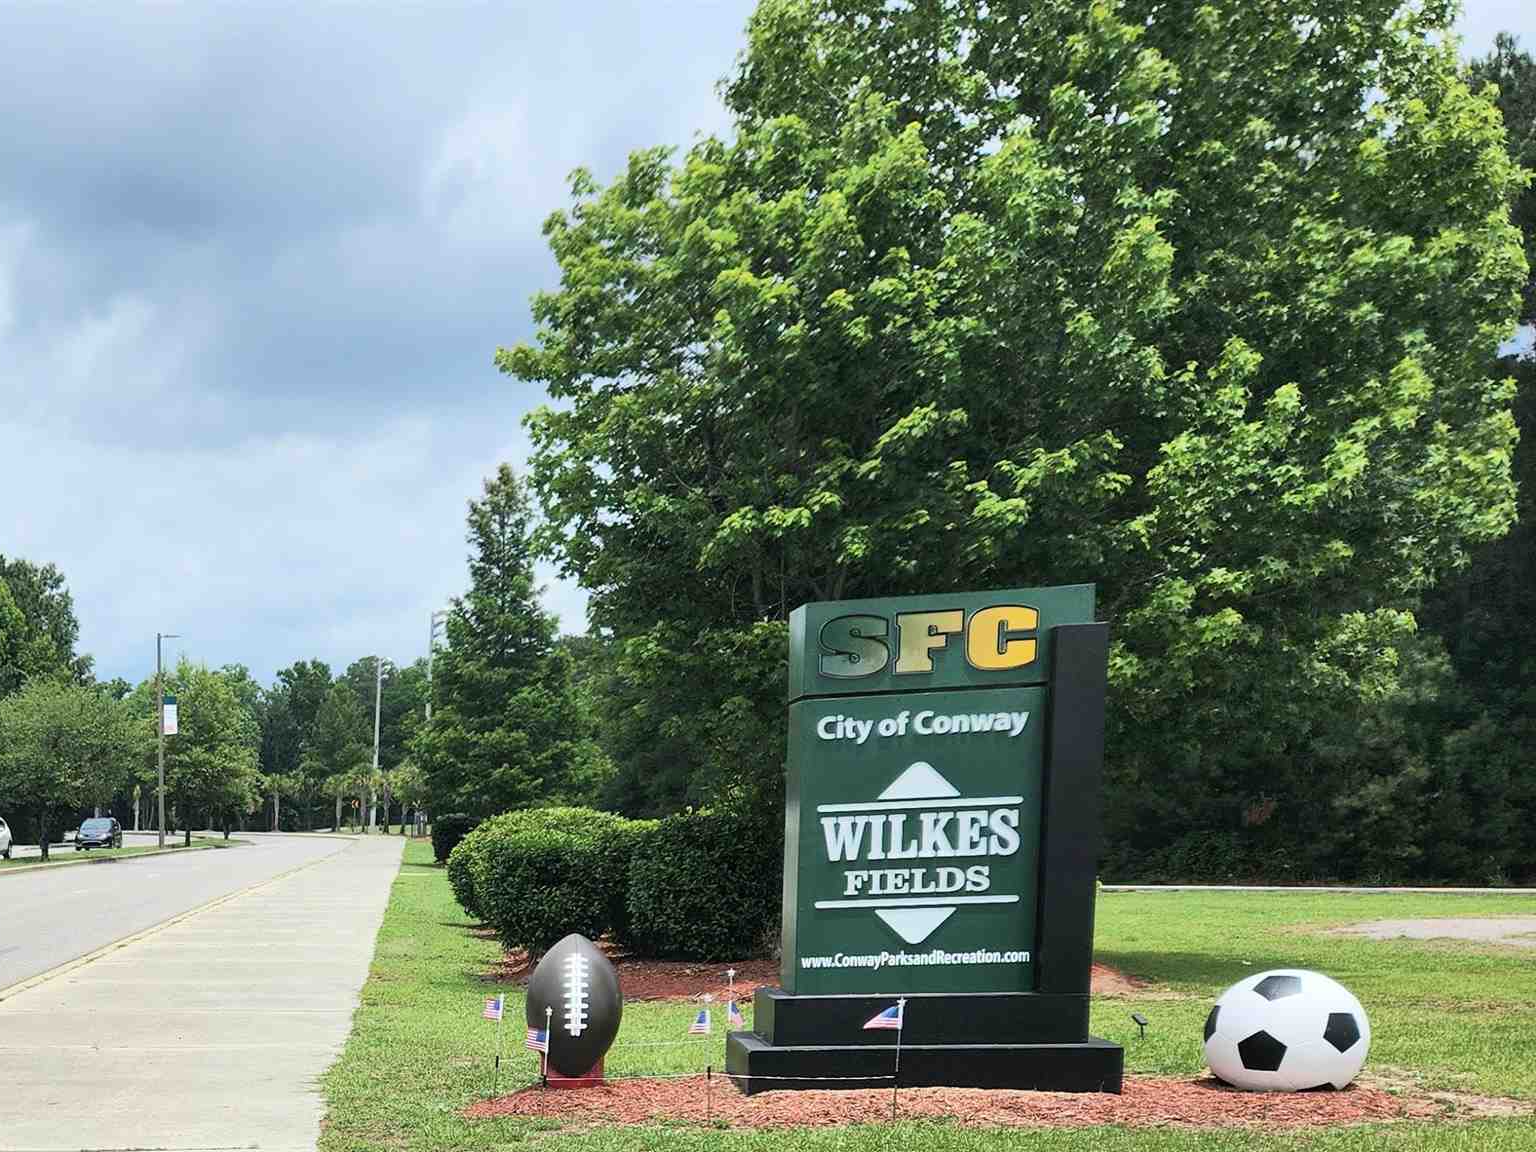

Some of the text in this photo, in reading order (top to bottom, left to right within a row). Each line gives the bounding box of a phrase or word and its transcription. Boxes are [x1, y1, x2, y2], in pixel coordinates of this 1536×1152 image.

[818, 604, 1039, 678] SFC
[816, 710, 1030, 744] City of Conway
[820, 808, 1020, 861] WILKES
[843, 865, 991, 895] FIELDS
[801, 949, 1030, 970] www.ConwayParksandRecreation.com
